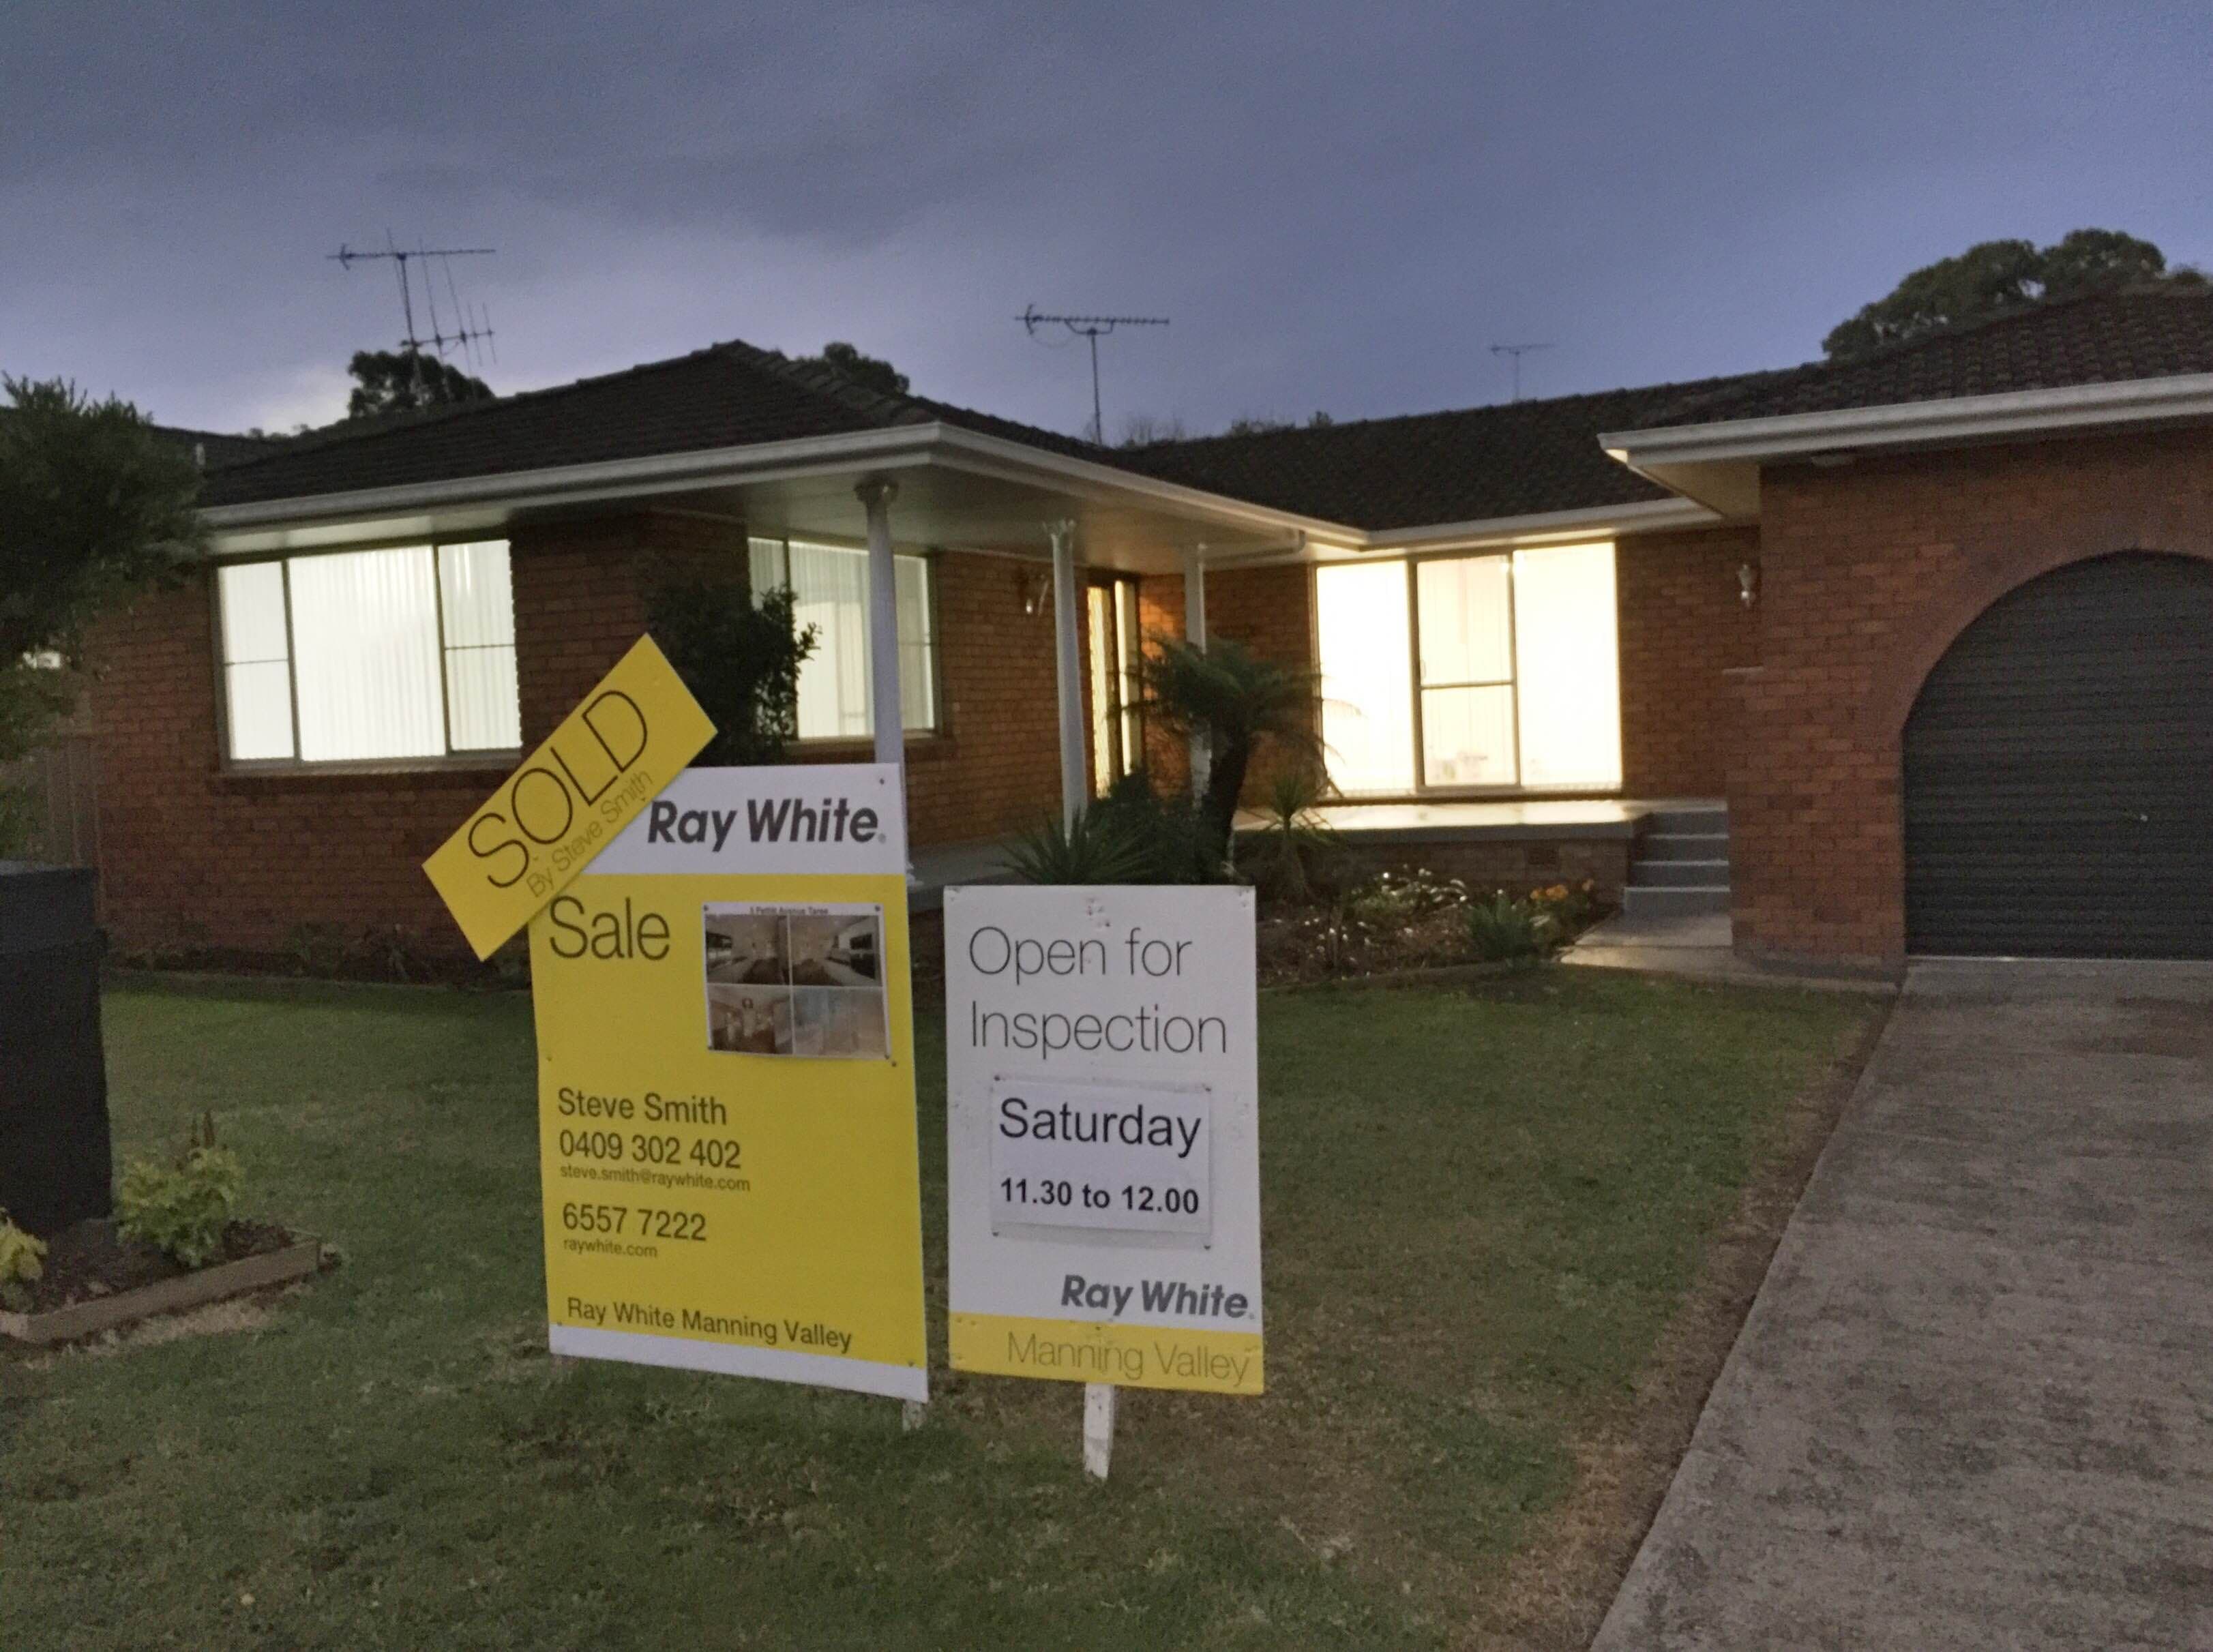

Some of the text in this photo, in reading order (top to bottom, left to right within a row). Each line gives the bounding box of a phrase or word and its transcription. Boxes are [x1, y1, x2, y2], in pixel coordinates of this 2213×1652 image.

[469, 690, 648, 888] SOLD
[526, 768, 654, 899] By Steve Smith
[647, 799, 737, 852] Ray
[550, 896, 670, 961] Sale
[969, 925, 1193, 986] Open for
[972, 1000, 1227, 1060] Inspection
[558, 1087, 728, 1126] Steve Smith
[999, 1097, 1202, 1159] Saturday
[559, 1129, 742, 1169] 0409 302 402
[560, 1165, 751, 1192] steve.smith@raywhite.com
[1000, 1177, 1200, 1215] 11.30 to 12.00
[562, 1202, 707, 1242] 6557 7222
[563, 1237, 659, 1259] raywhite.com
[1060, 1274, 1133, 1316] Ray
[567, 1297, 853, 1355] Ray White Manning Valley
[1007, 1331, 1251, 1389] Manning Valley
